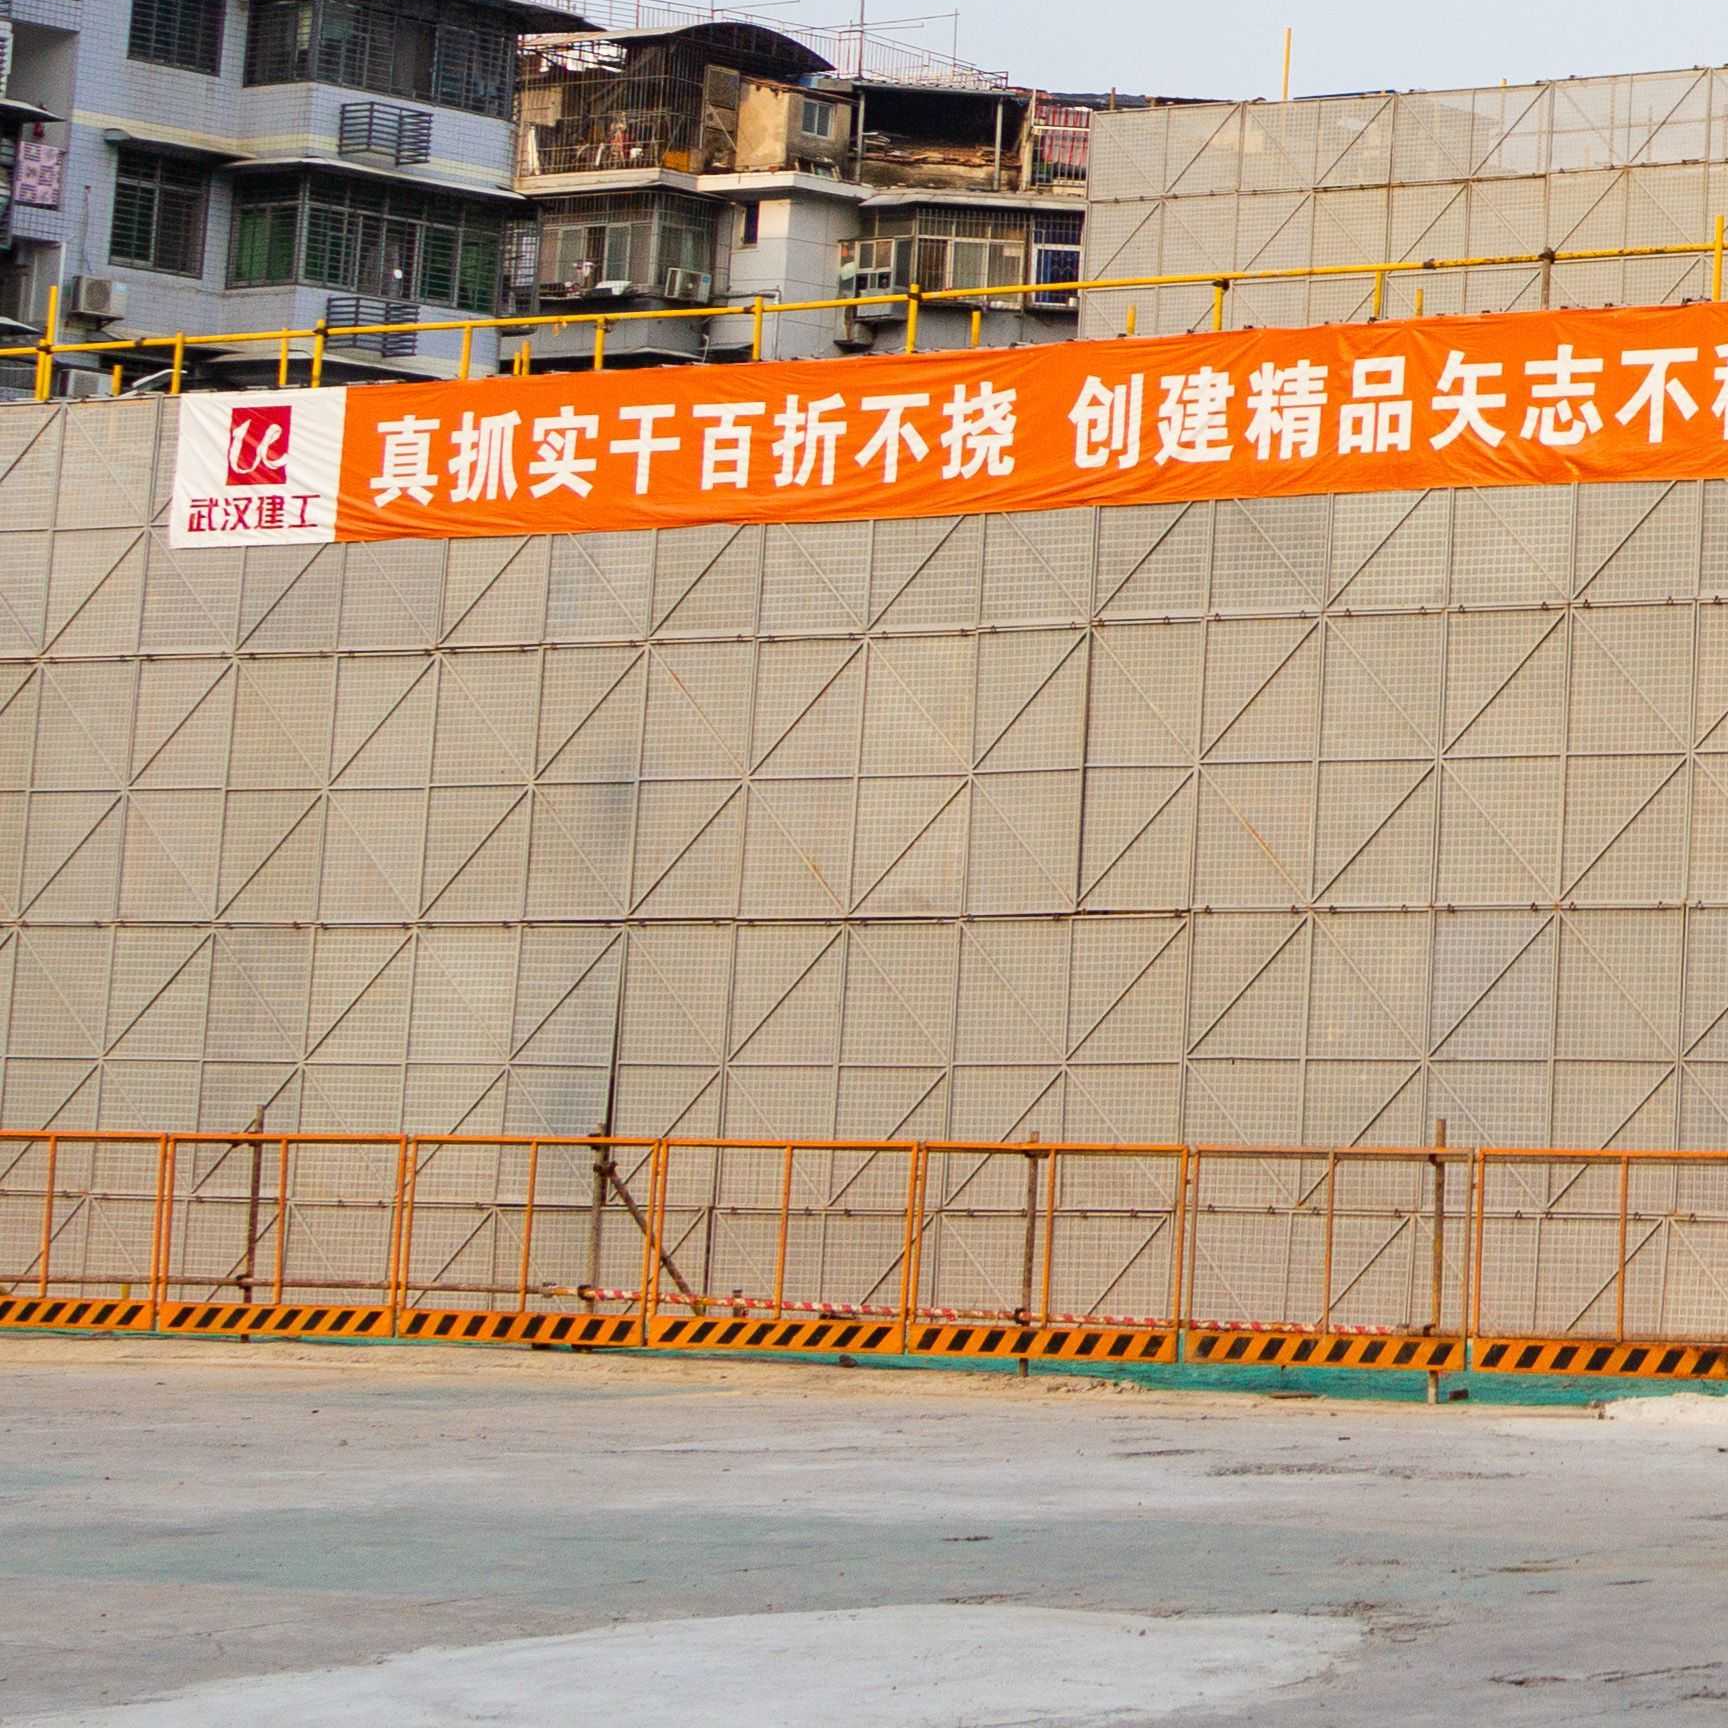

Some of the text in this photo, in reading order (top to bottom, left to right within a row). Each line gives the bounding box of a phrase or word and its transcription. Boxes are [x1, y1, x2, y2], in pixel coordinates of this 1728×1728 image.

[369, 381, 1019, 508] 真抓实干百折不挠
[187, 494, 321, 532] 武汉建工
